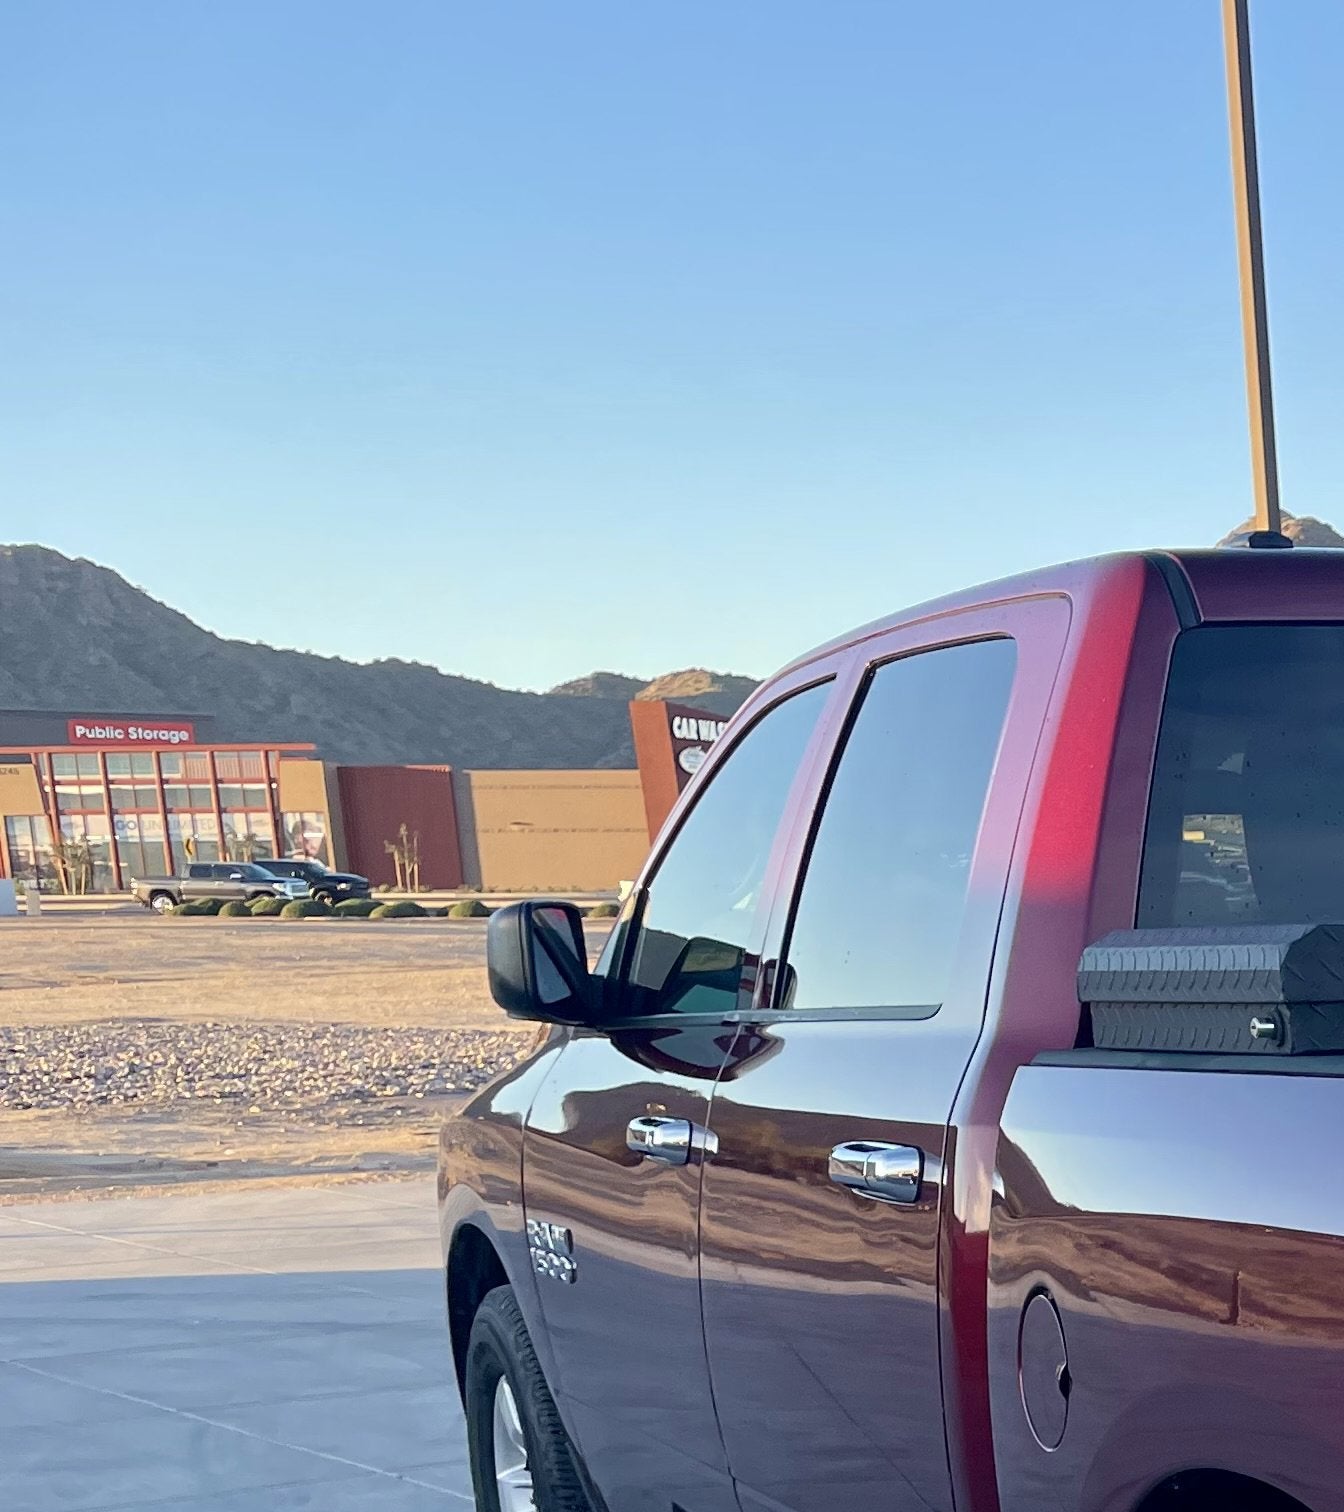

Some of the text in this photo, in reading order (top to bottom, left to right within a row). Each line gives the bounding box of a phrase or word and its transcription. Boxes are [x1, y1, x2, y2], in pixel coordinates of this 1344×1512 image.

[74, 725, 189, 744] Public Storage
[672, 716, 698, 740] CAR
